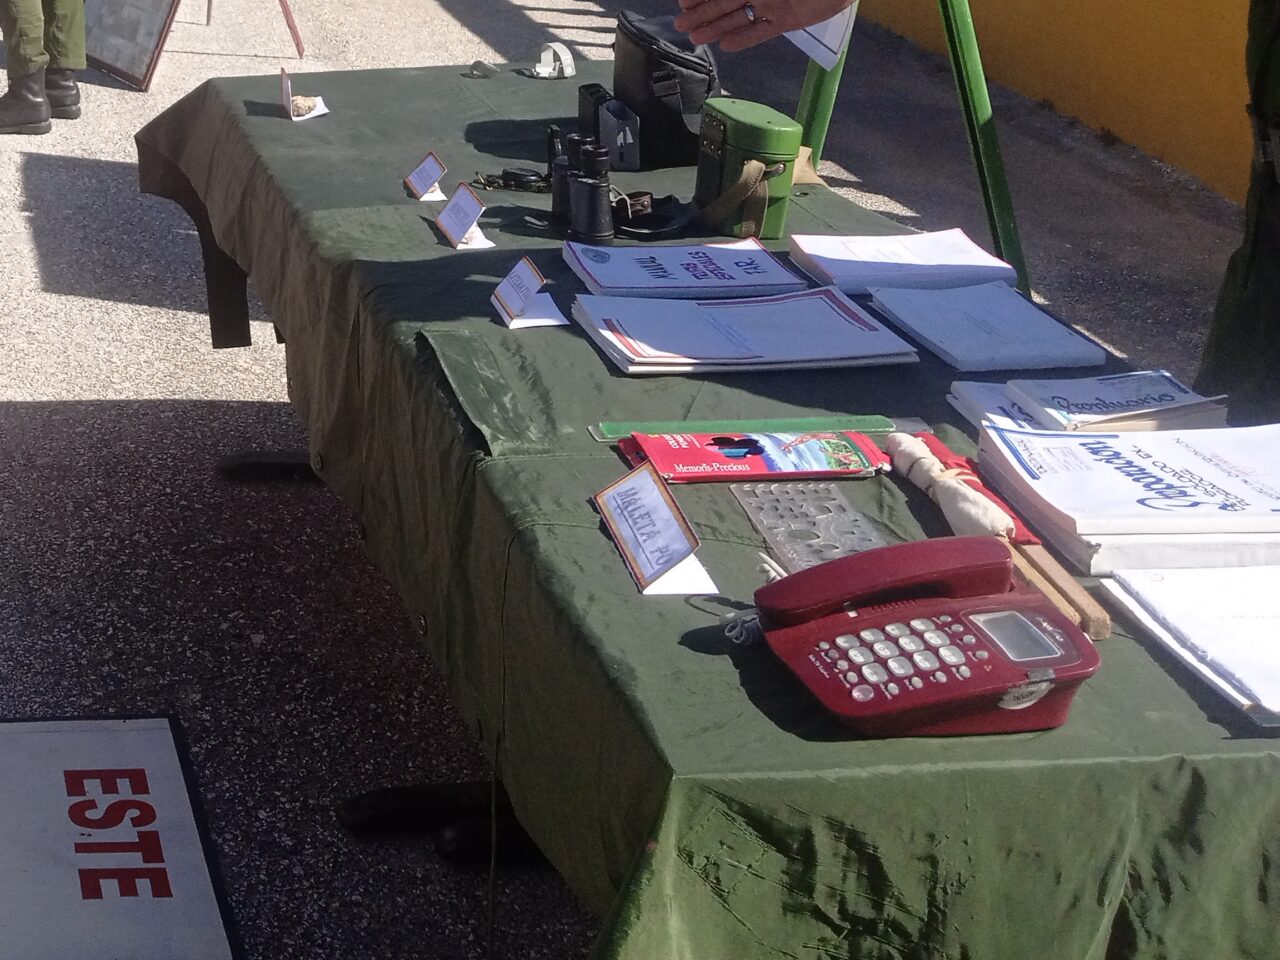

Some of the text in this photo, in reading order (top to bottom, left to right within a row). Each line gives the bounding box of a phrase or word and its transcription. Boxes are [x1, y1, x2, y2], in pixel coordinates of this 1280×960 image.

[1051, 393, 1175, 414] Prontuario
[674, 461, 751, 473] Memoris-Precious
[1152, 460, 1216, 497] SOLDADO
[63, 768, 173, 900] ESTE
